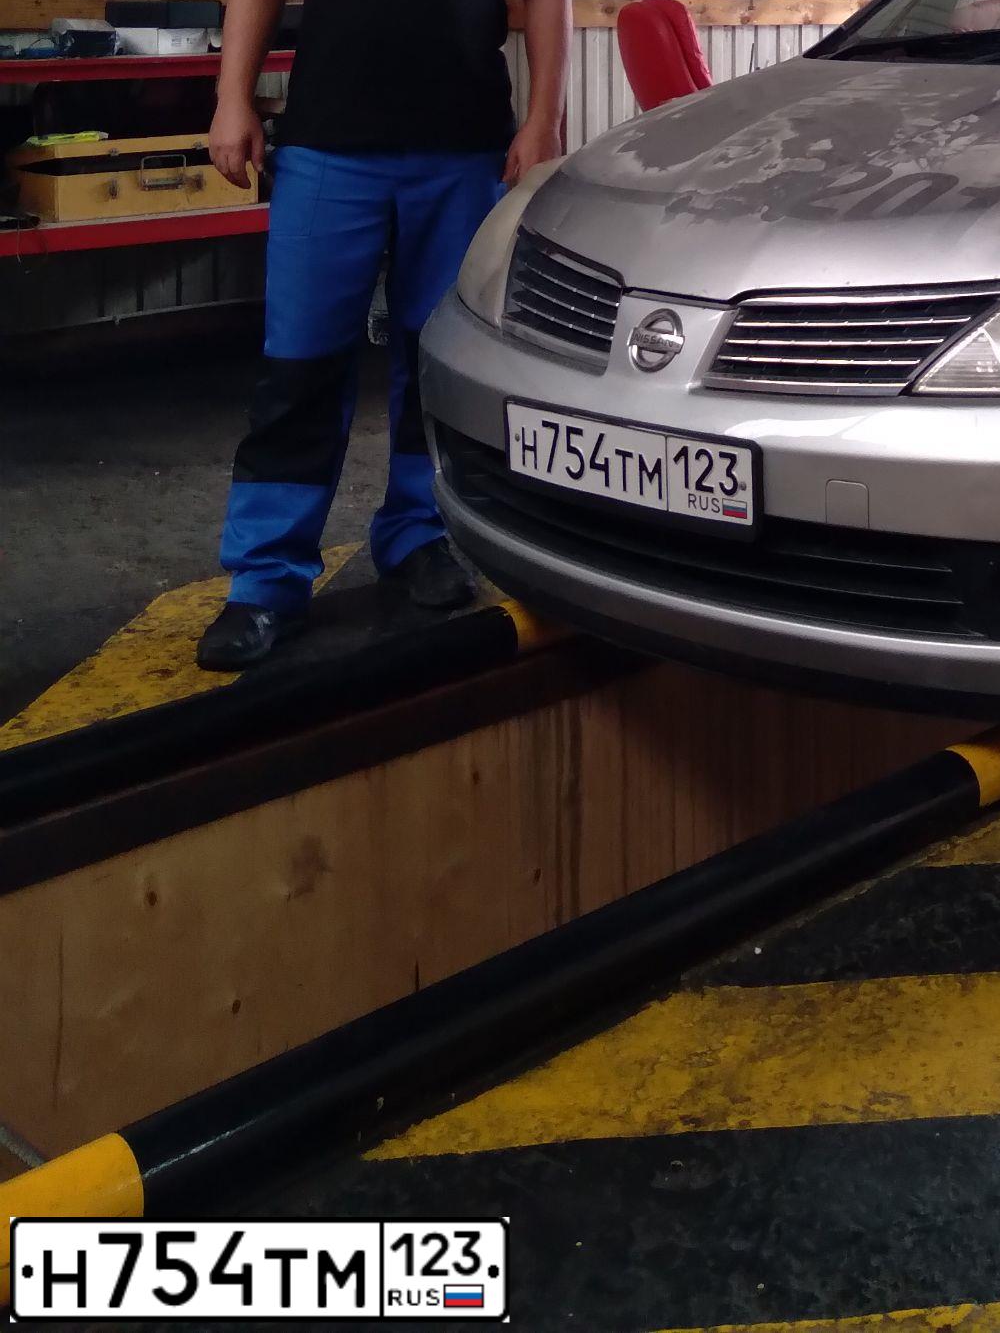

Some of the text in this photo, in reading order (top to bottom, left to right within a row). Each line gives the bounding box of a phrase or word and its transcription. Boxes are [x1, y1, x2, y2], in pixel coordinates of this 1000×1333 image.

[631, 332, 675, 348] NISSAN
[673, 445, 739, 496] 123
[688, 493, 721, 514] RUS
